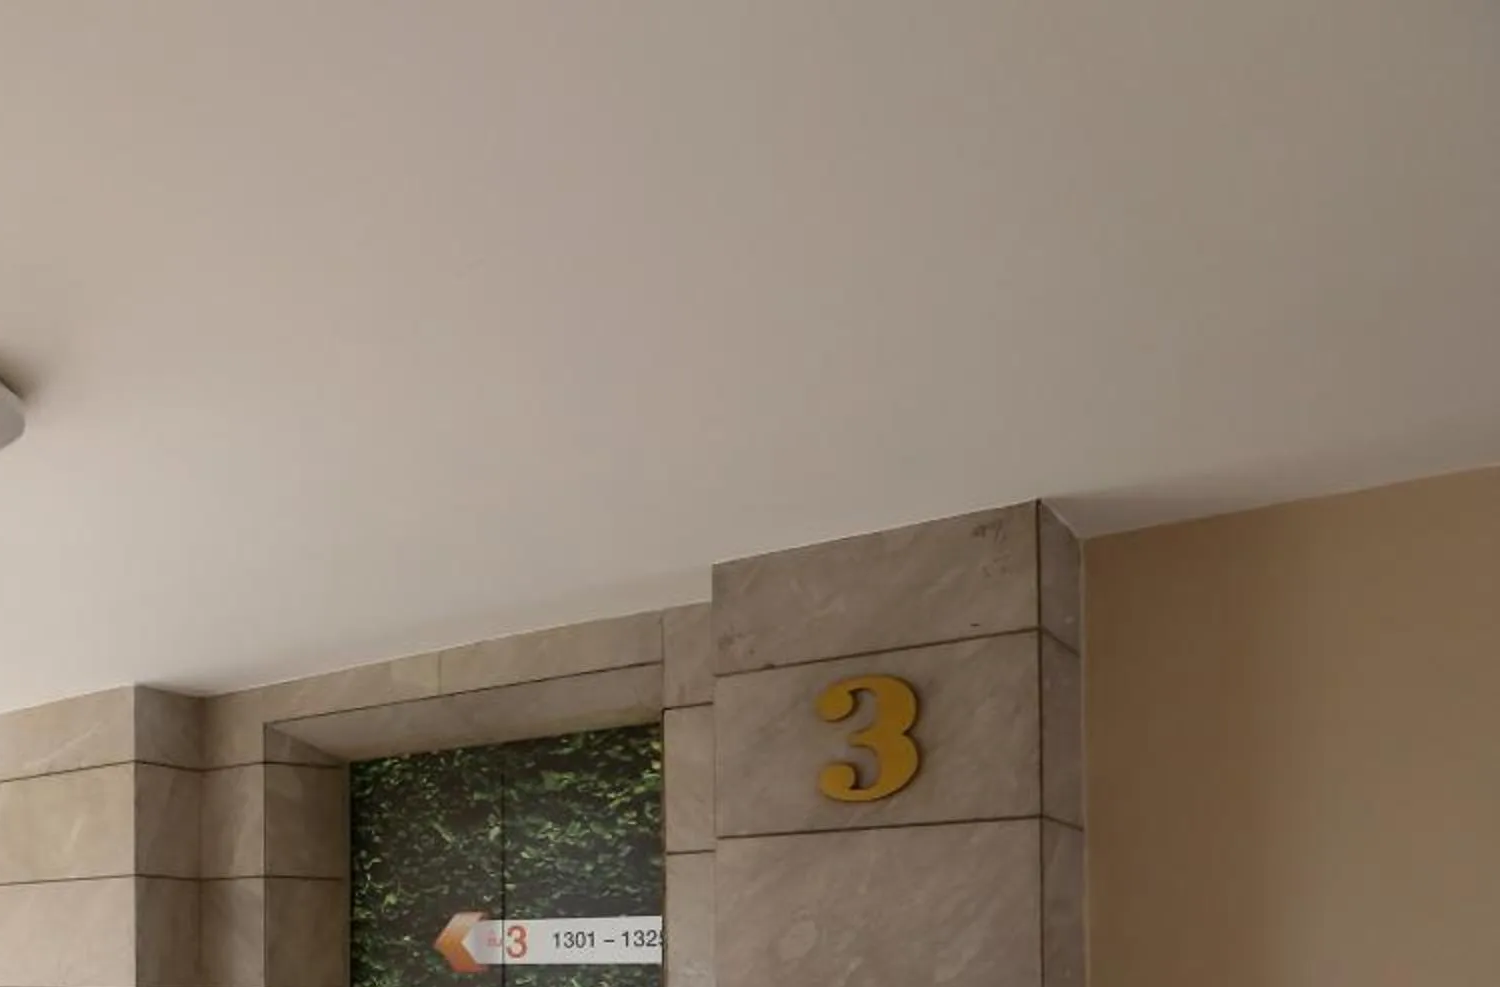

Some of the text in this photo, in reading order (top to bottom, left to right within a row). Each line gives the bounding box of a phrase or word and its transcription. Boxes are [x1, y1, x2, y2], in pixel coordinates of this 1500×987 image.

[814, 673, 921, 803] 3
[506, 925, 528, 958] 3
[553, 930, 595, 949] 1301
